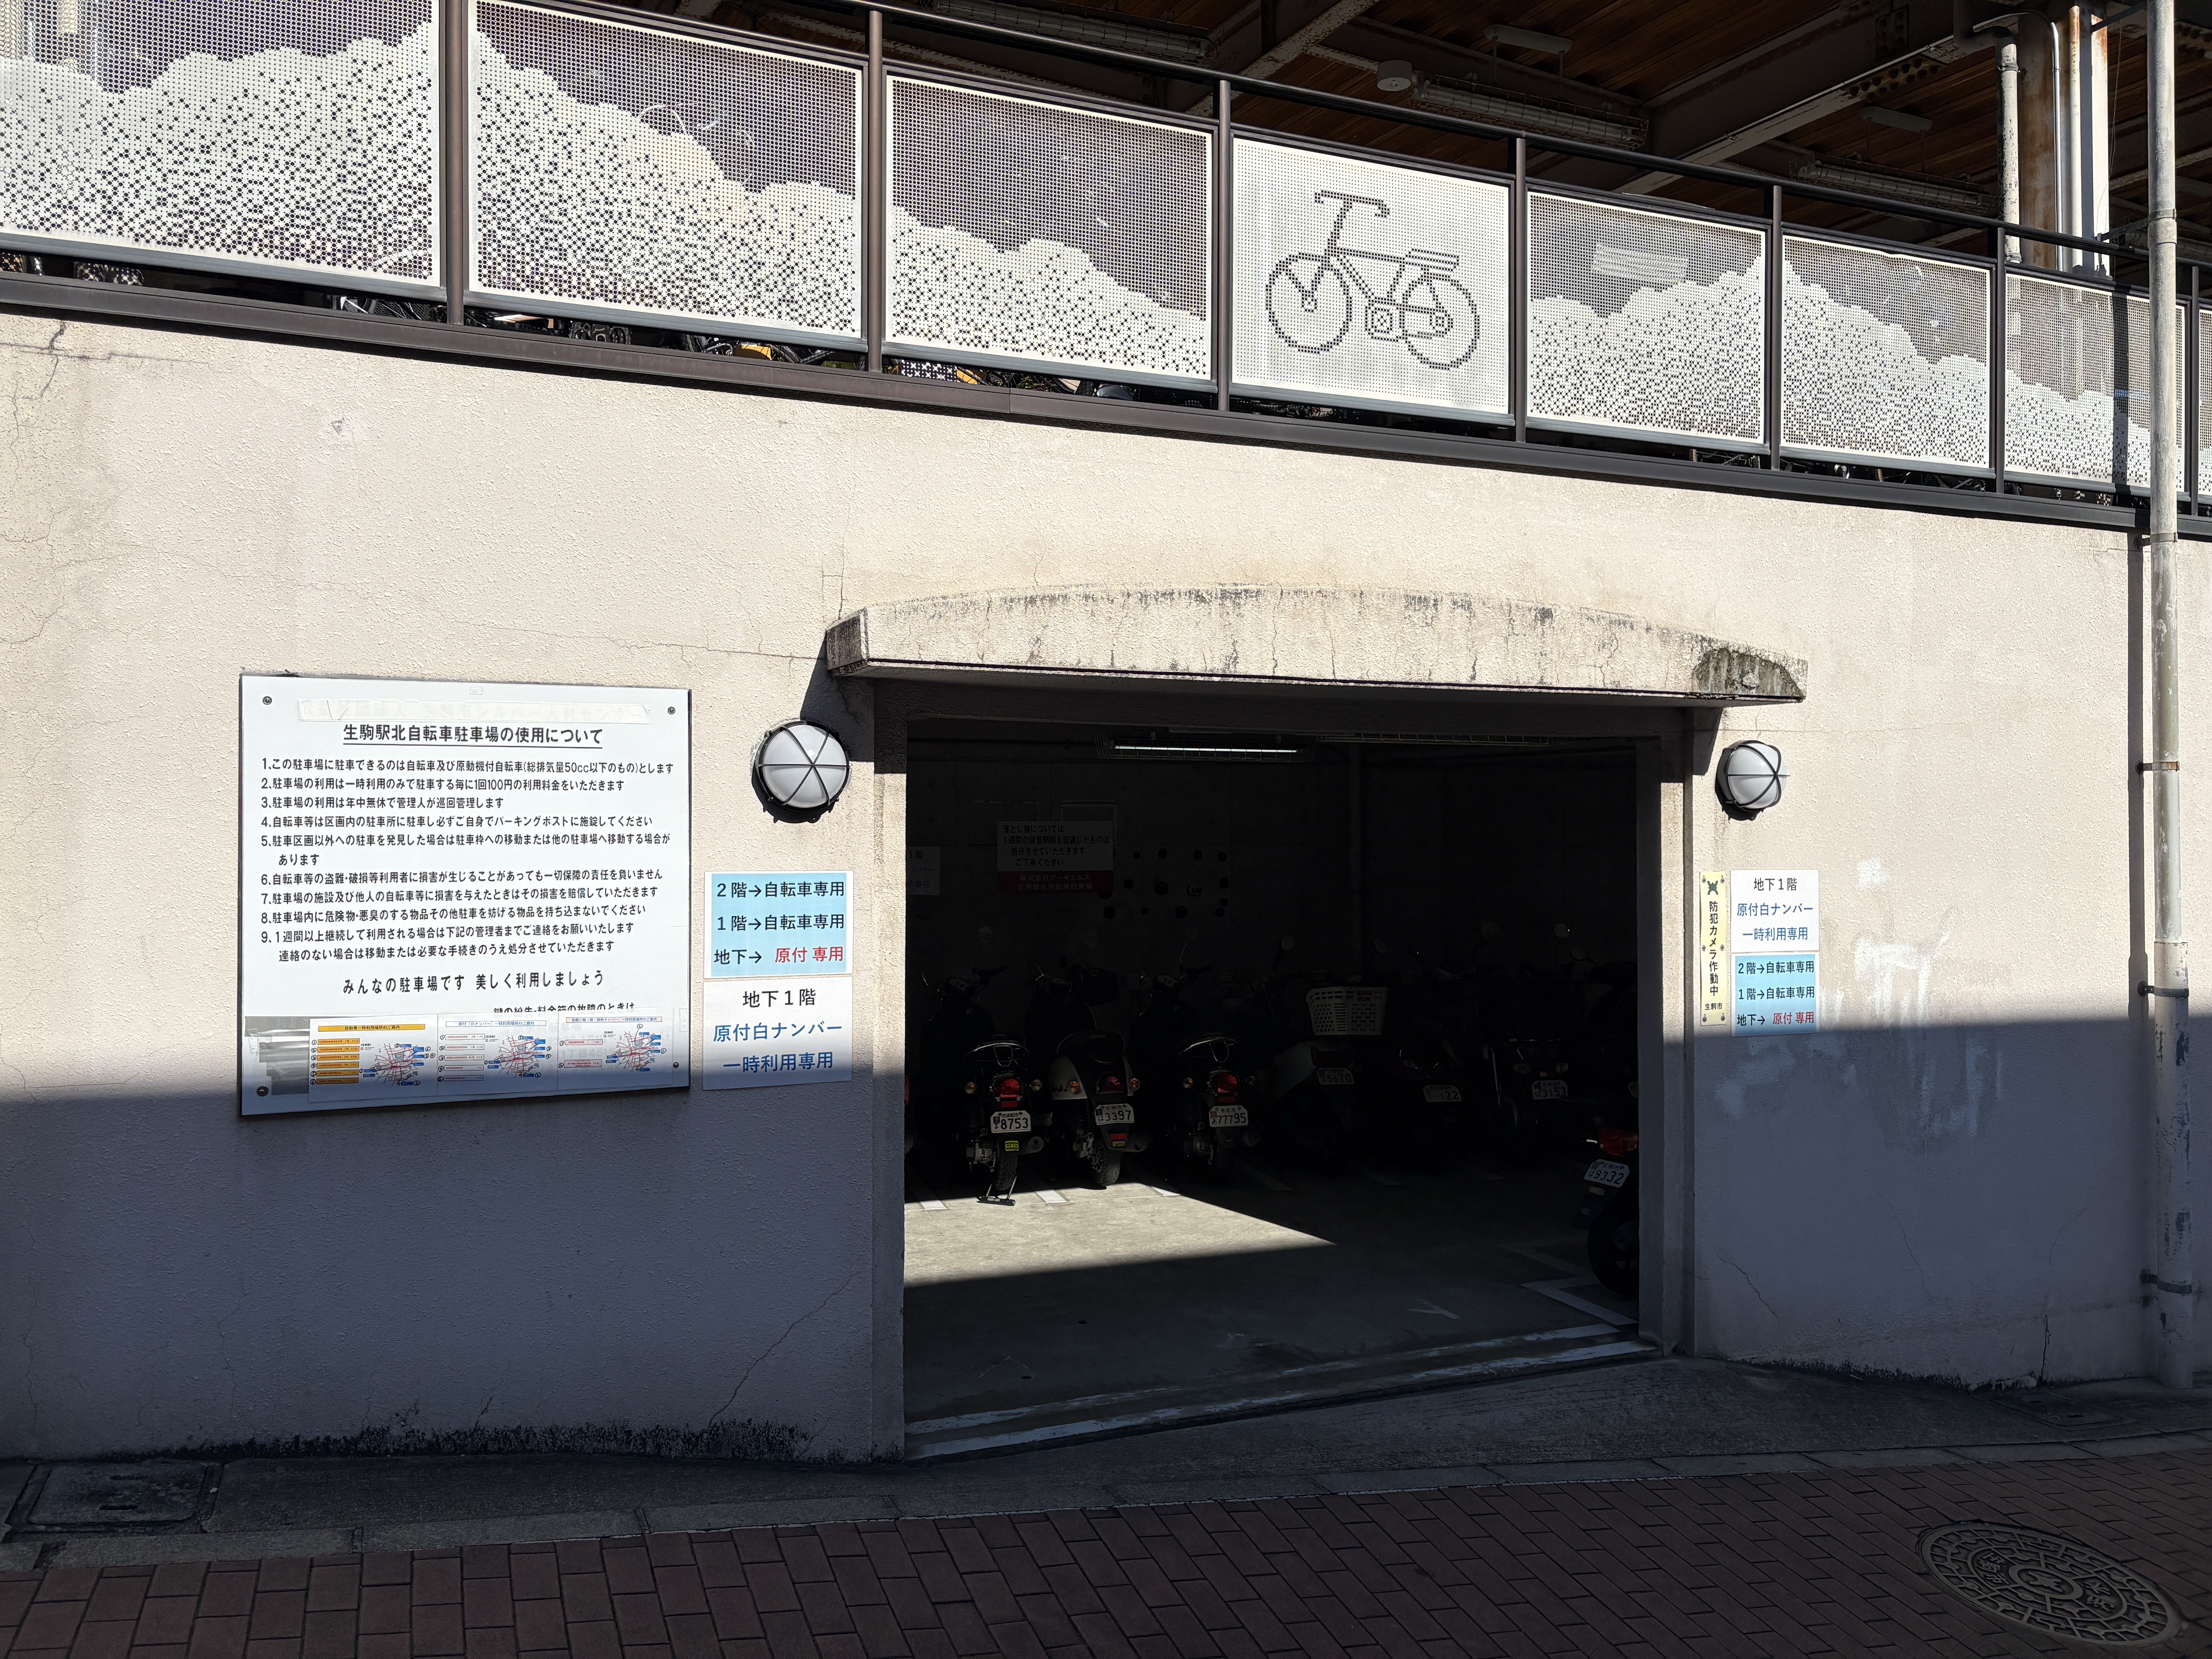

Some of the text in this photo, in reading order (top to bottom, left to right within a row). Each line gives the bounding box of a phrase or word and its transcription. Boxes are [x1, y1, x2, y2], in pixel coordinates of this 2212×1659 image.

[343, 724, 602, 744] 生駒駅北自転車駐車場の使用について
[279, 854, 319, 866] あります
[717, 881, 844, 898] 2階 自転車専用
[1753, 878, 1797, 891] 地下1階
[1737, 902, 1813, 916] 原付白ナンバー
[717, 914, 844, 931] 1階 自転車専用
[1743, 927, 1808, 941] 一時利用専用
[714, 946, 843, 964] 地下 原付 専用
[1709, 901, 1718, 996] 防犯カメラ作動中
[1738, 961, 1814, 974] 2階 自転車専用
[343, 970, 602, 994] みんなの駐車場です 美しく利用しましょう
[743, 989, 816, 1008] 地下1階
[1738, 986, 1815, 1000] 1階 自転車専用
[1705, 1002, 1723, 1010] 生駒市
[1737, 1011, 1814, 1026] 地下 原付 専用
[713, 1020, 842, 1042] 原付白ナンバー
[723, 1051, 833, 1073] 一時利用専用
[1326, 1073, 1352, 1082] 5670
[1105, 1110, 1131, 1121] 3397
[1217, 1113, 1246, 1124] 77795
[1001, 1118, 1028, 1130] 8753
[1594, 1170, 1624, 1184] 9332
